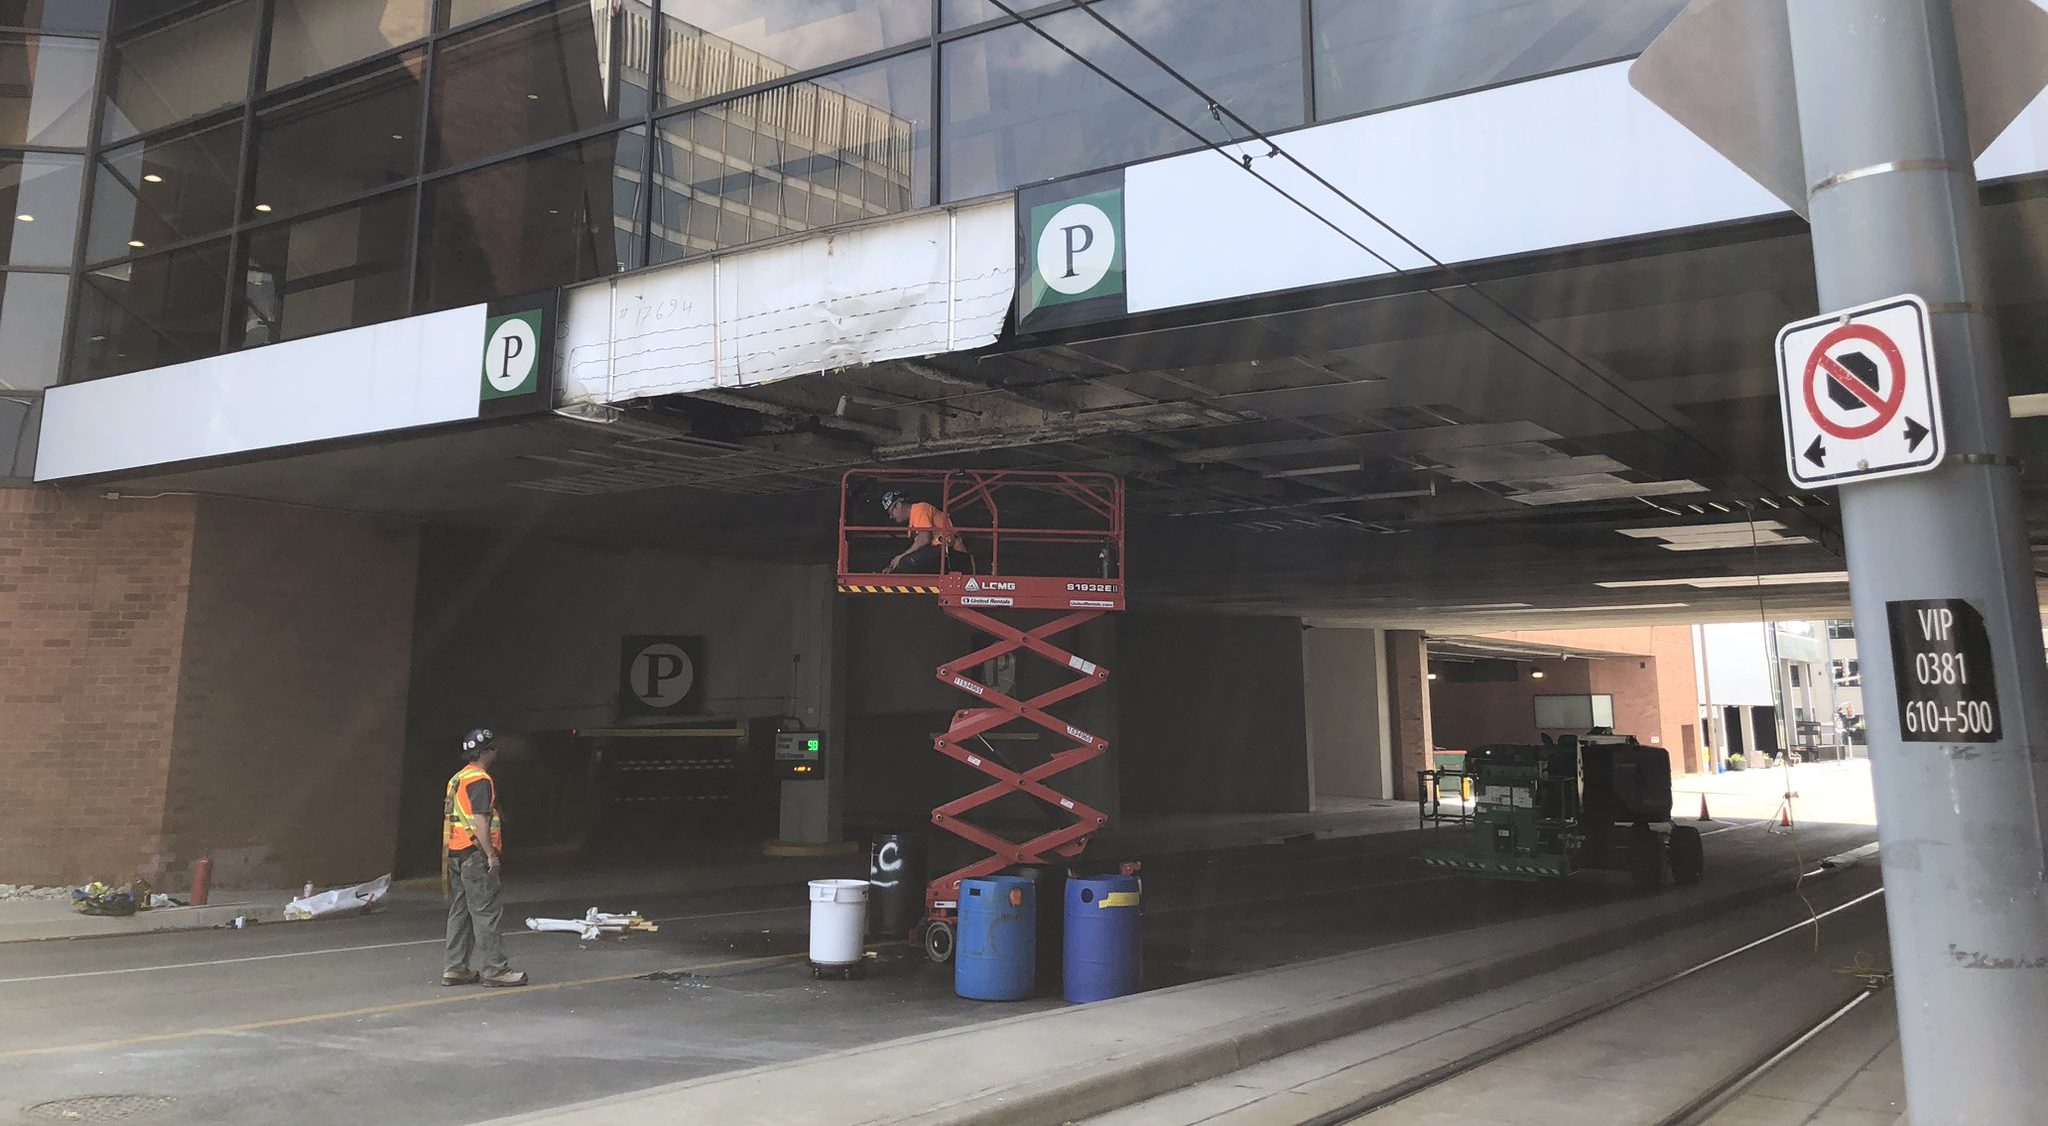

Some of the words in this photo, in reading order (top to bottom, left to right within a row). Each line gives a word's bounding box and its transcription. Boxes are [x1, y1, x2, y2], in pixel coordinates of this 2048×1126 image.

[1059, 224, 1094, 279] P
[498, 335, 523, 379] P
[1917, 608, 1953, 641] VIP
[640, 653, 684, 699] P
[1915, 652, 1967, 685] 0381
[1906, 700, 1993, 733] 610+500
